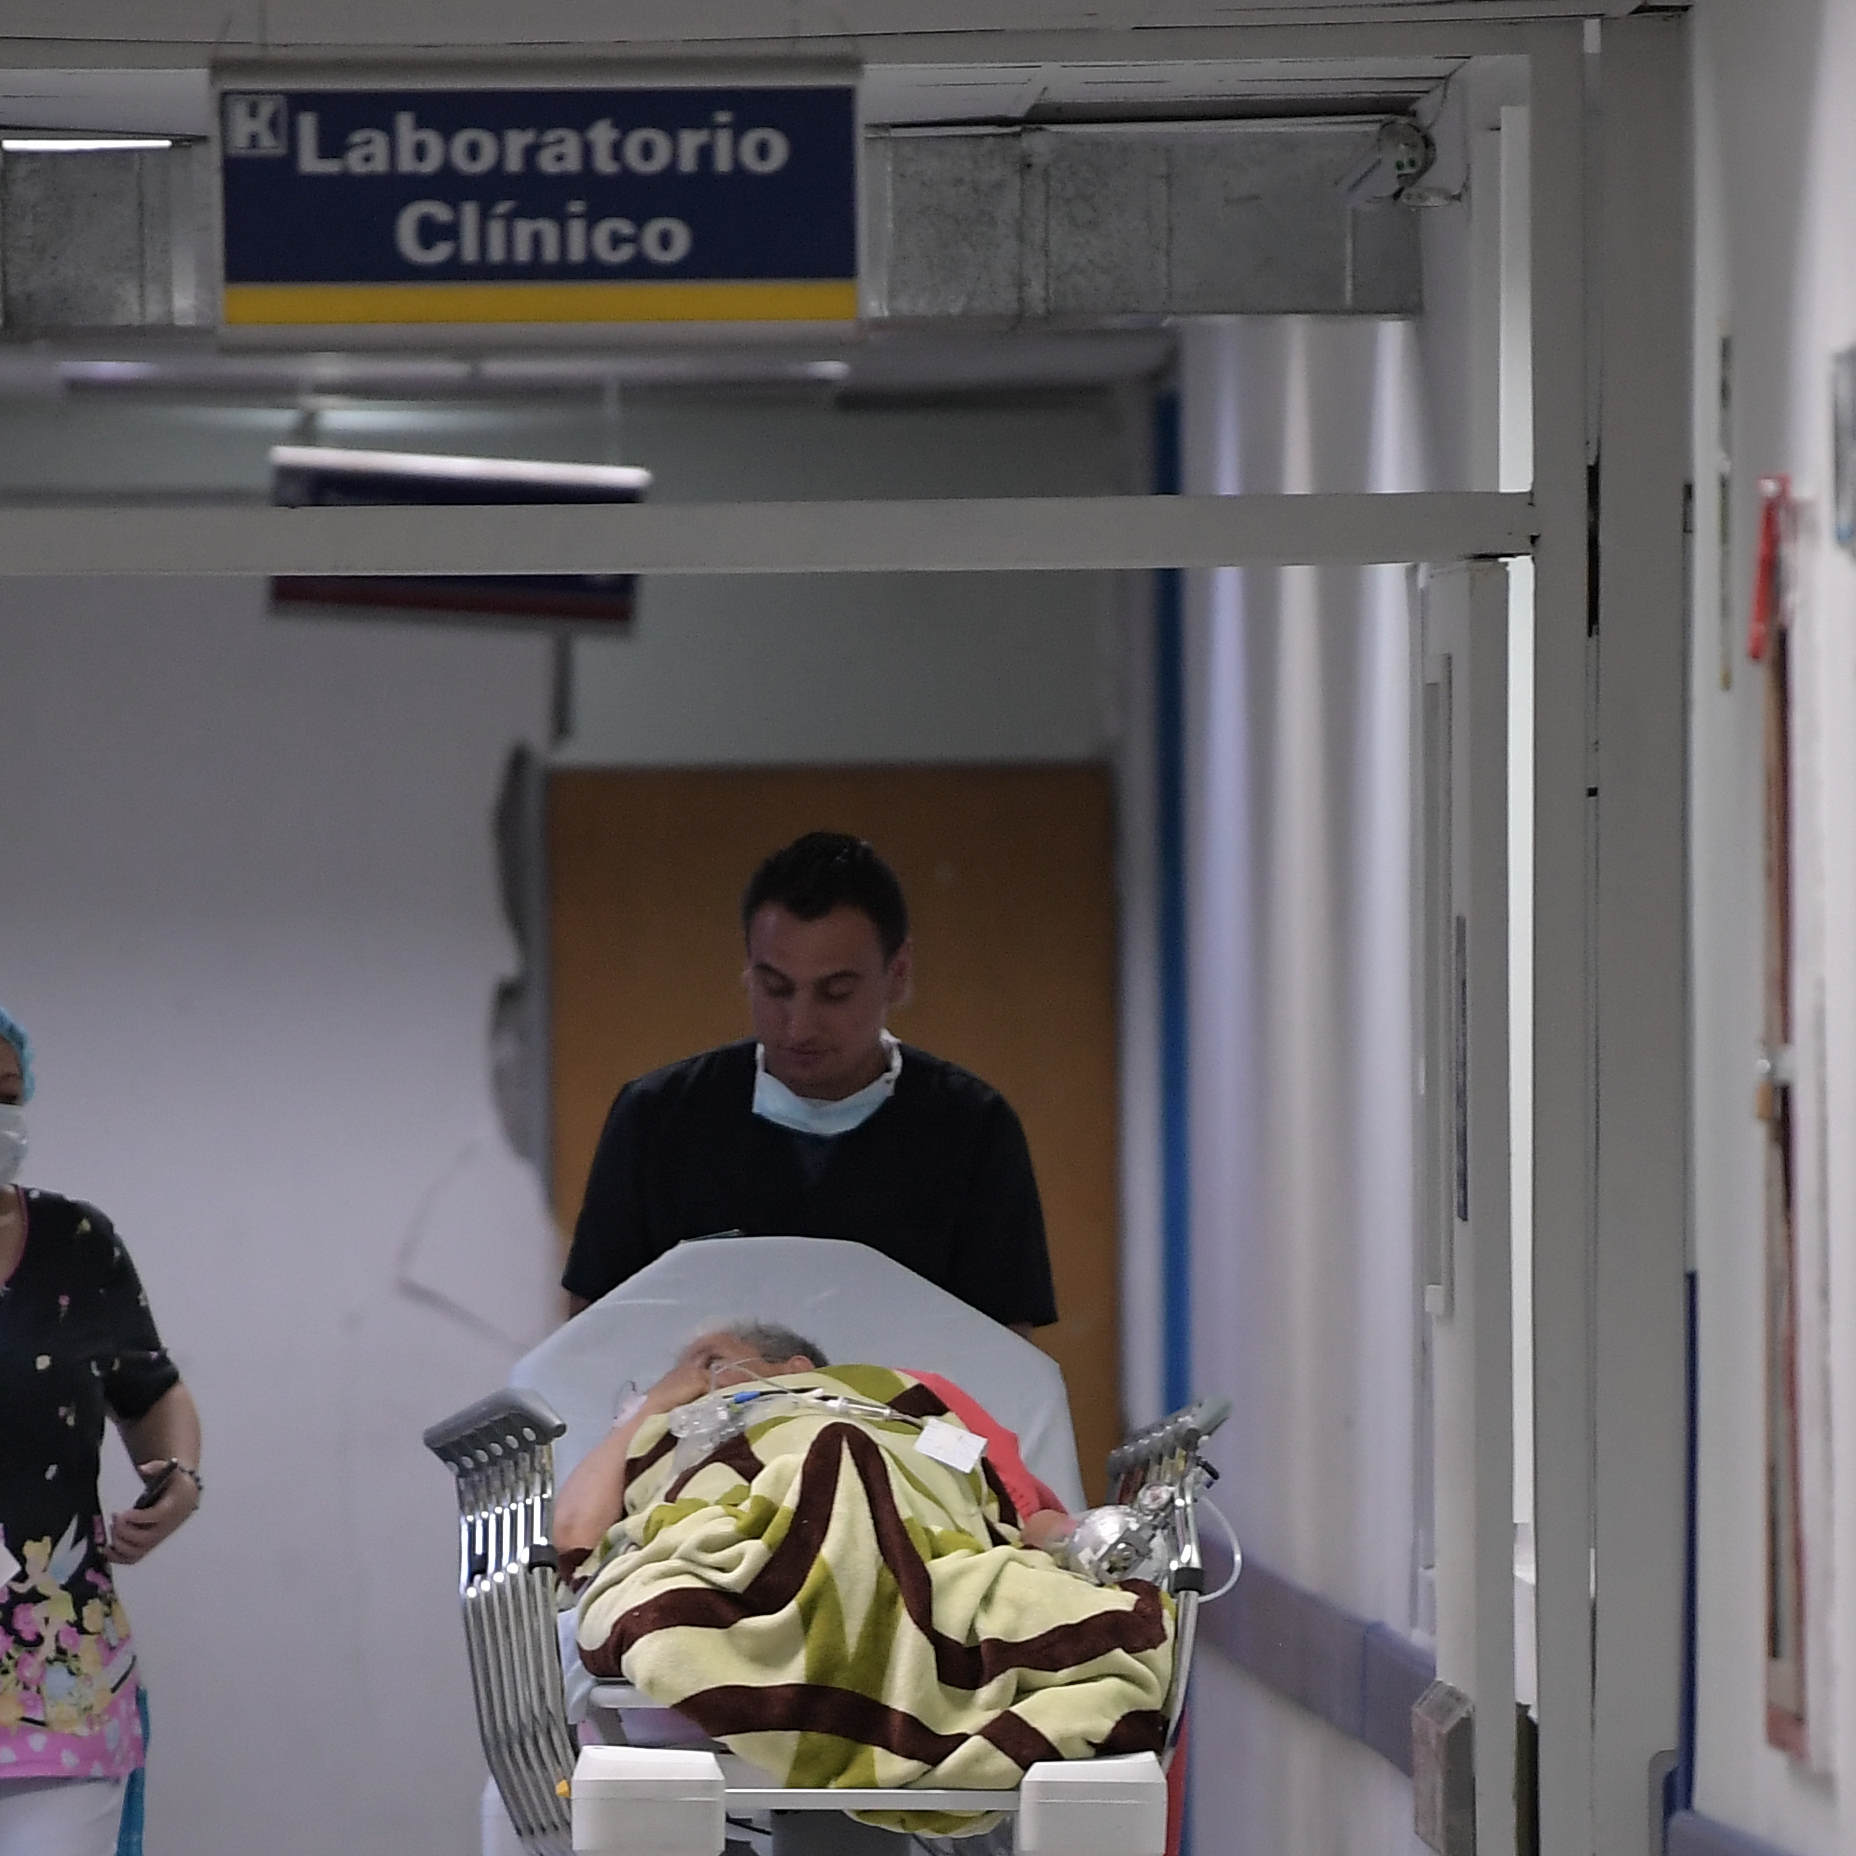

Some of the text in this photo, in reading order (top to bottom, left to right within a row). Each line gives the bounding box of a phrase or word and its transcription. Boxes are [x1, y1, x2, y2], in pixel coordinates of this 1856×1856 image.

[232, 100, 278, 148] K
[296, 111, 789, 174] Laboratorio
[396, 200, 691, 265] Clínico
